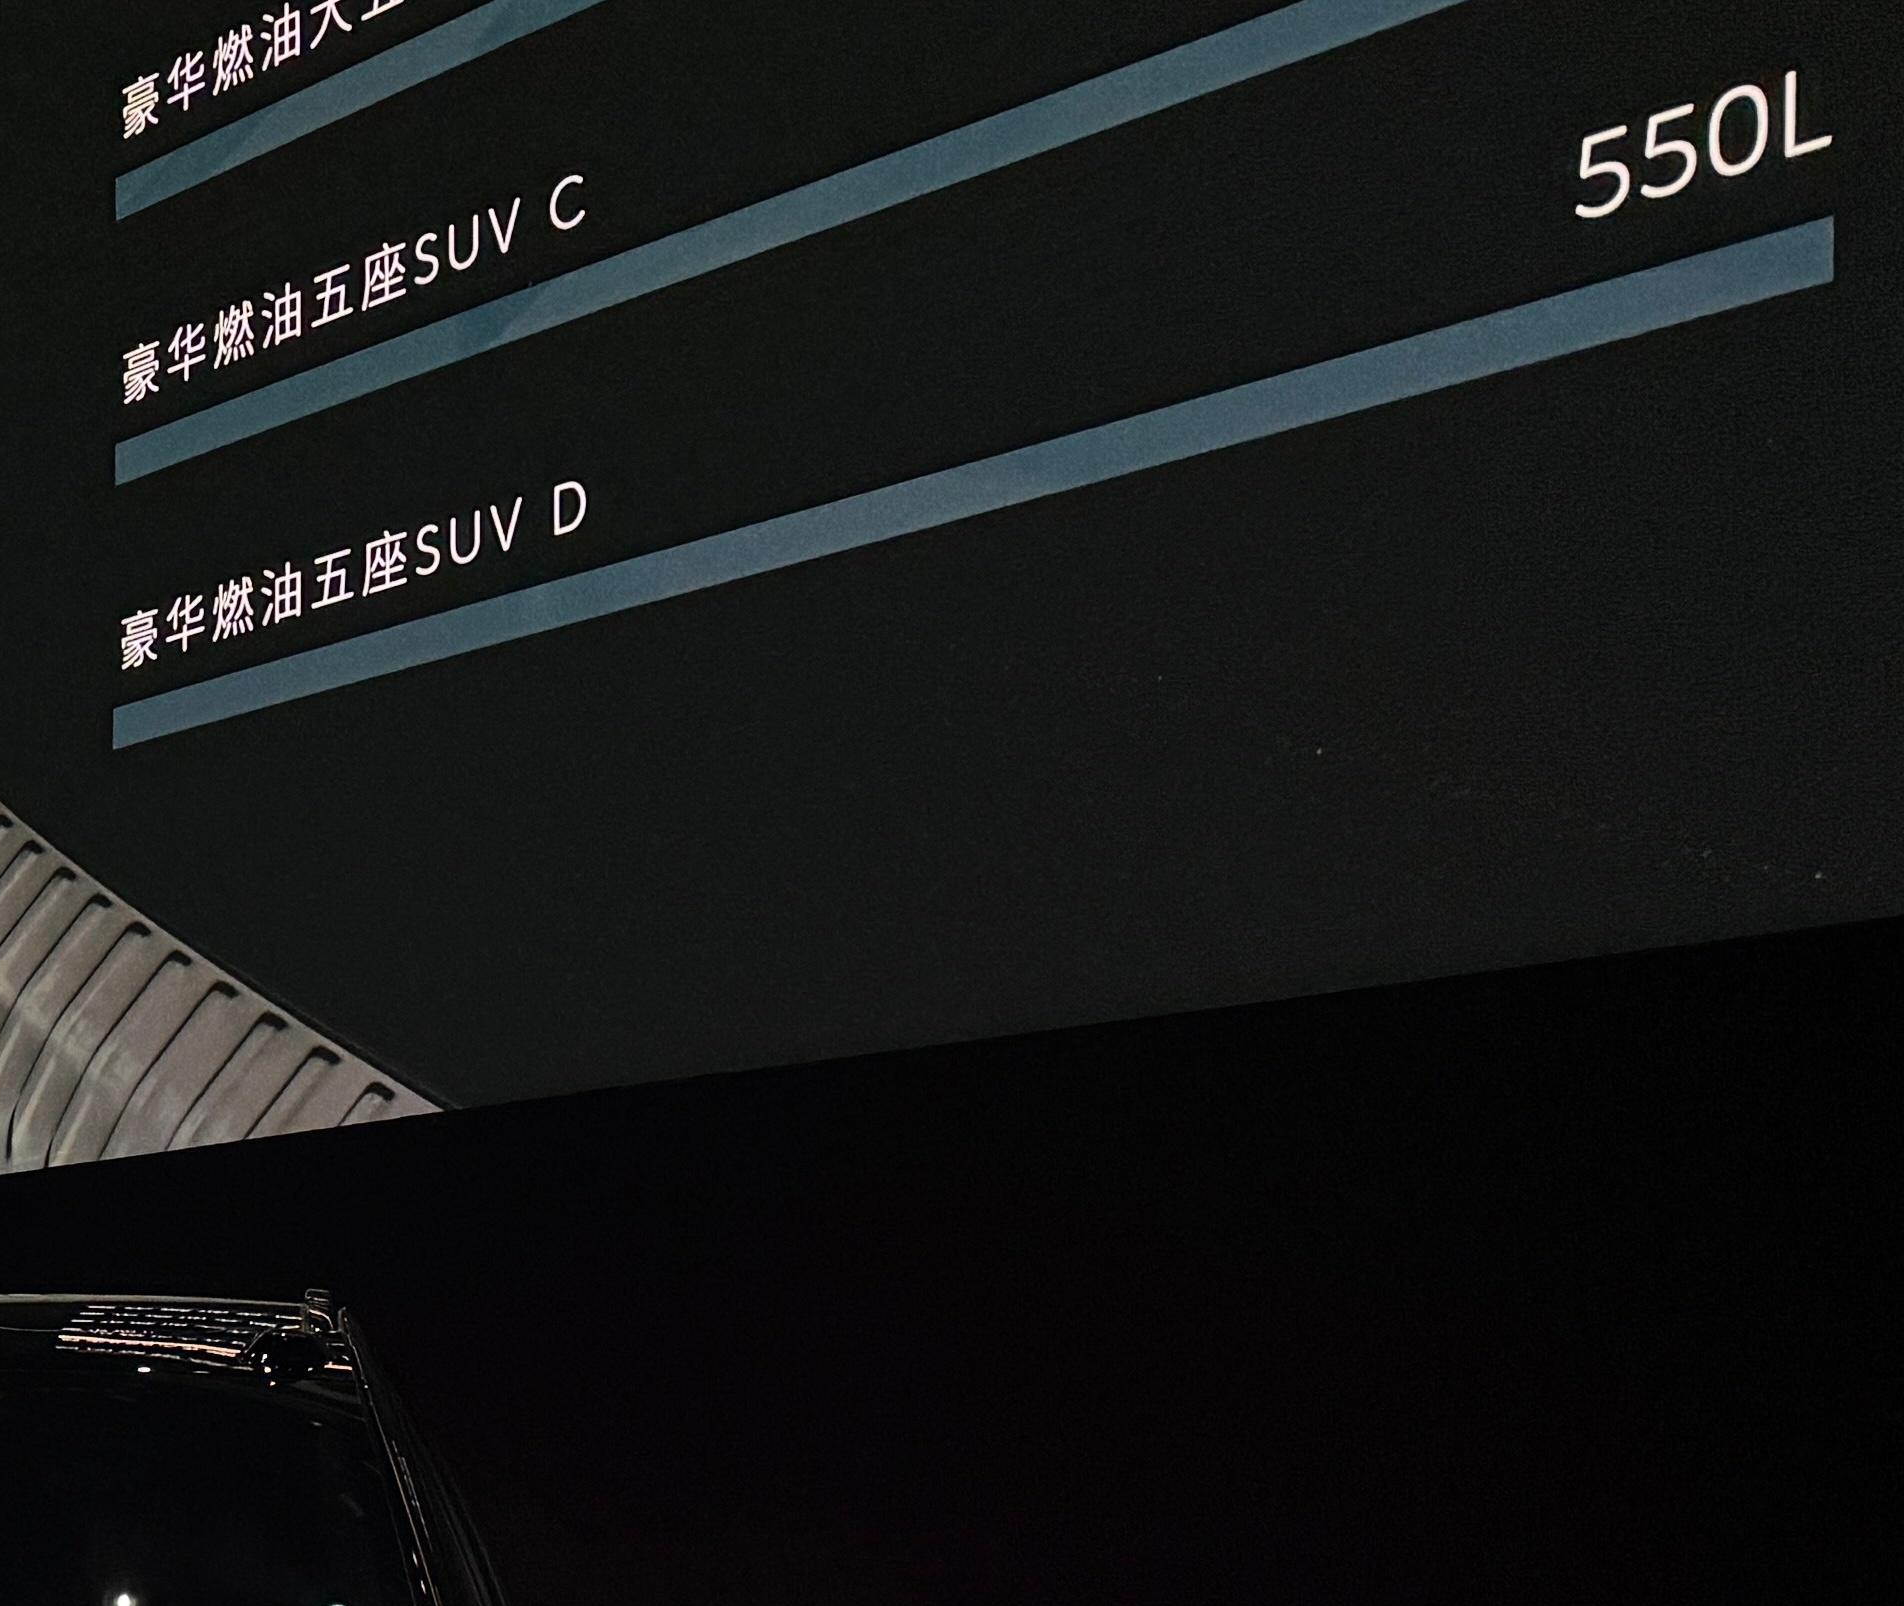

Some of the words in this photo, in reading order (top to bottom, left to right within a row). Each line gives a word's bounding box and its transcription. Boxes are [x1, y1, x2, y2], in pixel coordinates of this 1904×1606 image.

[1575, 70, 1833, 218] 550L
[122, 197, 521, 405] 豪华燃油五座SUV
[549, 174, 586, 230] C
[120, 496, 523, 670] 豪华燃油五座SUV
[553, 481, 587, 536] D
